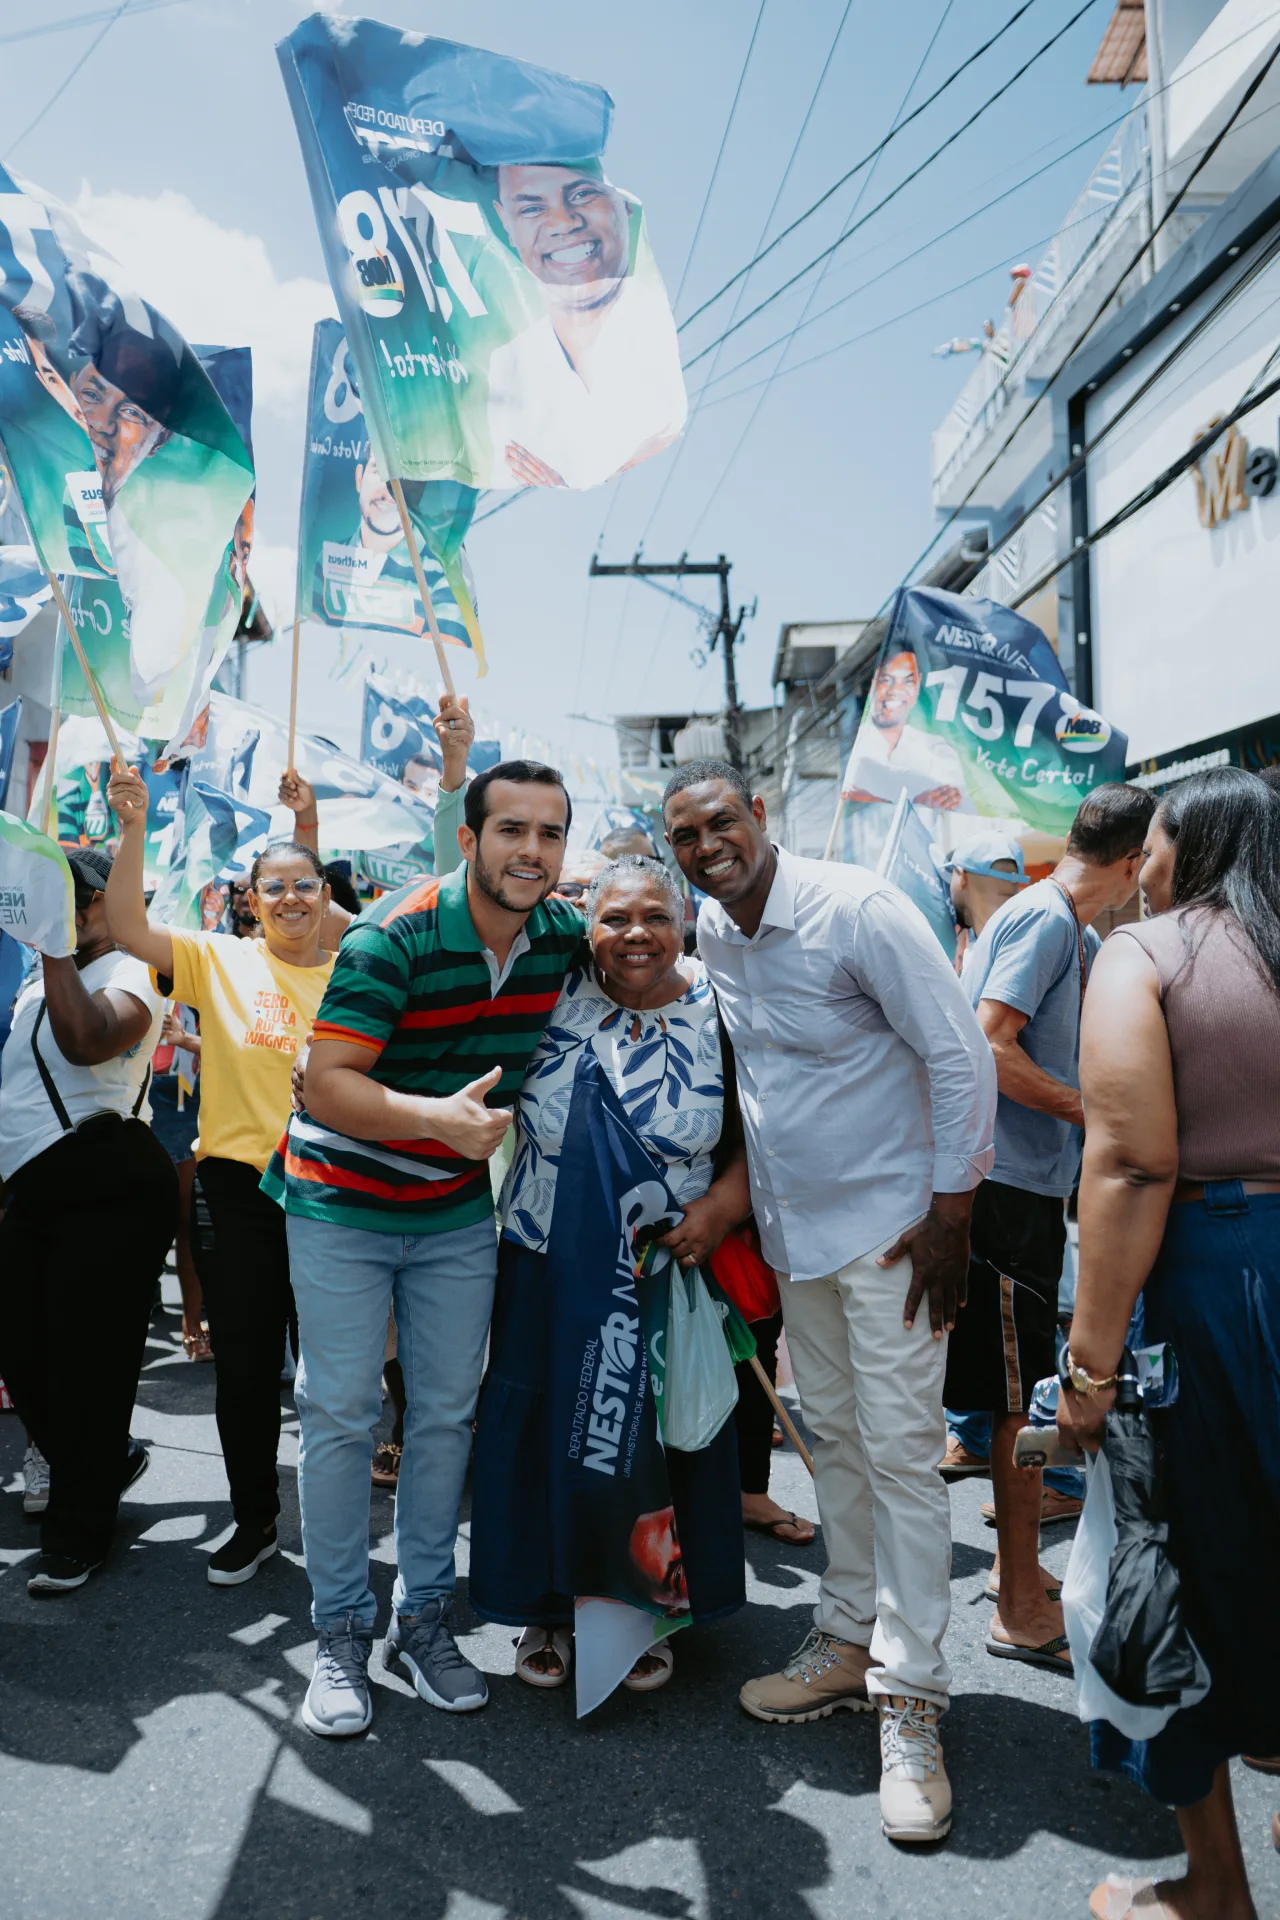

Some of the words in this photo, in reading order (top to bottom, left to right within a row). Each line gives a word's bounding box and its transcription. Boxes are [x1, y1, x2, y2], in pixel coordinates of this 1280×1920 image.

[934, 624, 998, 657] NESTOR
[1063, 713, 1102, 735] MDB
[975, 745, 1018, 779] Vote
[1020, 758, 1095, 785] Certo!
[253, 990, 289, 1009] JERO
[255, 1017, 275, 1033] RUI
[266, 1009, 296, 1027] LULA
[244, 1031, 298, 1053] WAGNER
[583, 1311, 639, 1476] NESTOR
[637, 1369, 647, 1399] AMOR
[568, 1391, 589, 1459] DEPUTADO
[580, 1338, 598, 1390] FEDERAL
[634, 1400, 643, 1414] DE
[625, 1414, 641, 1457] HISTÓRIA
[622, 1458, 633, 1478] UMA
